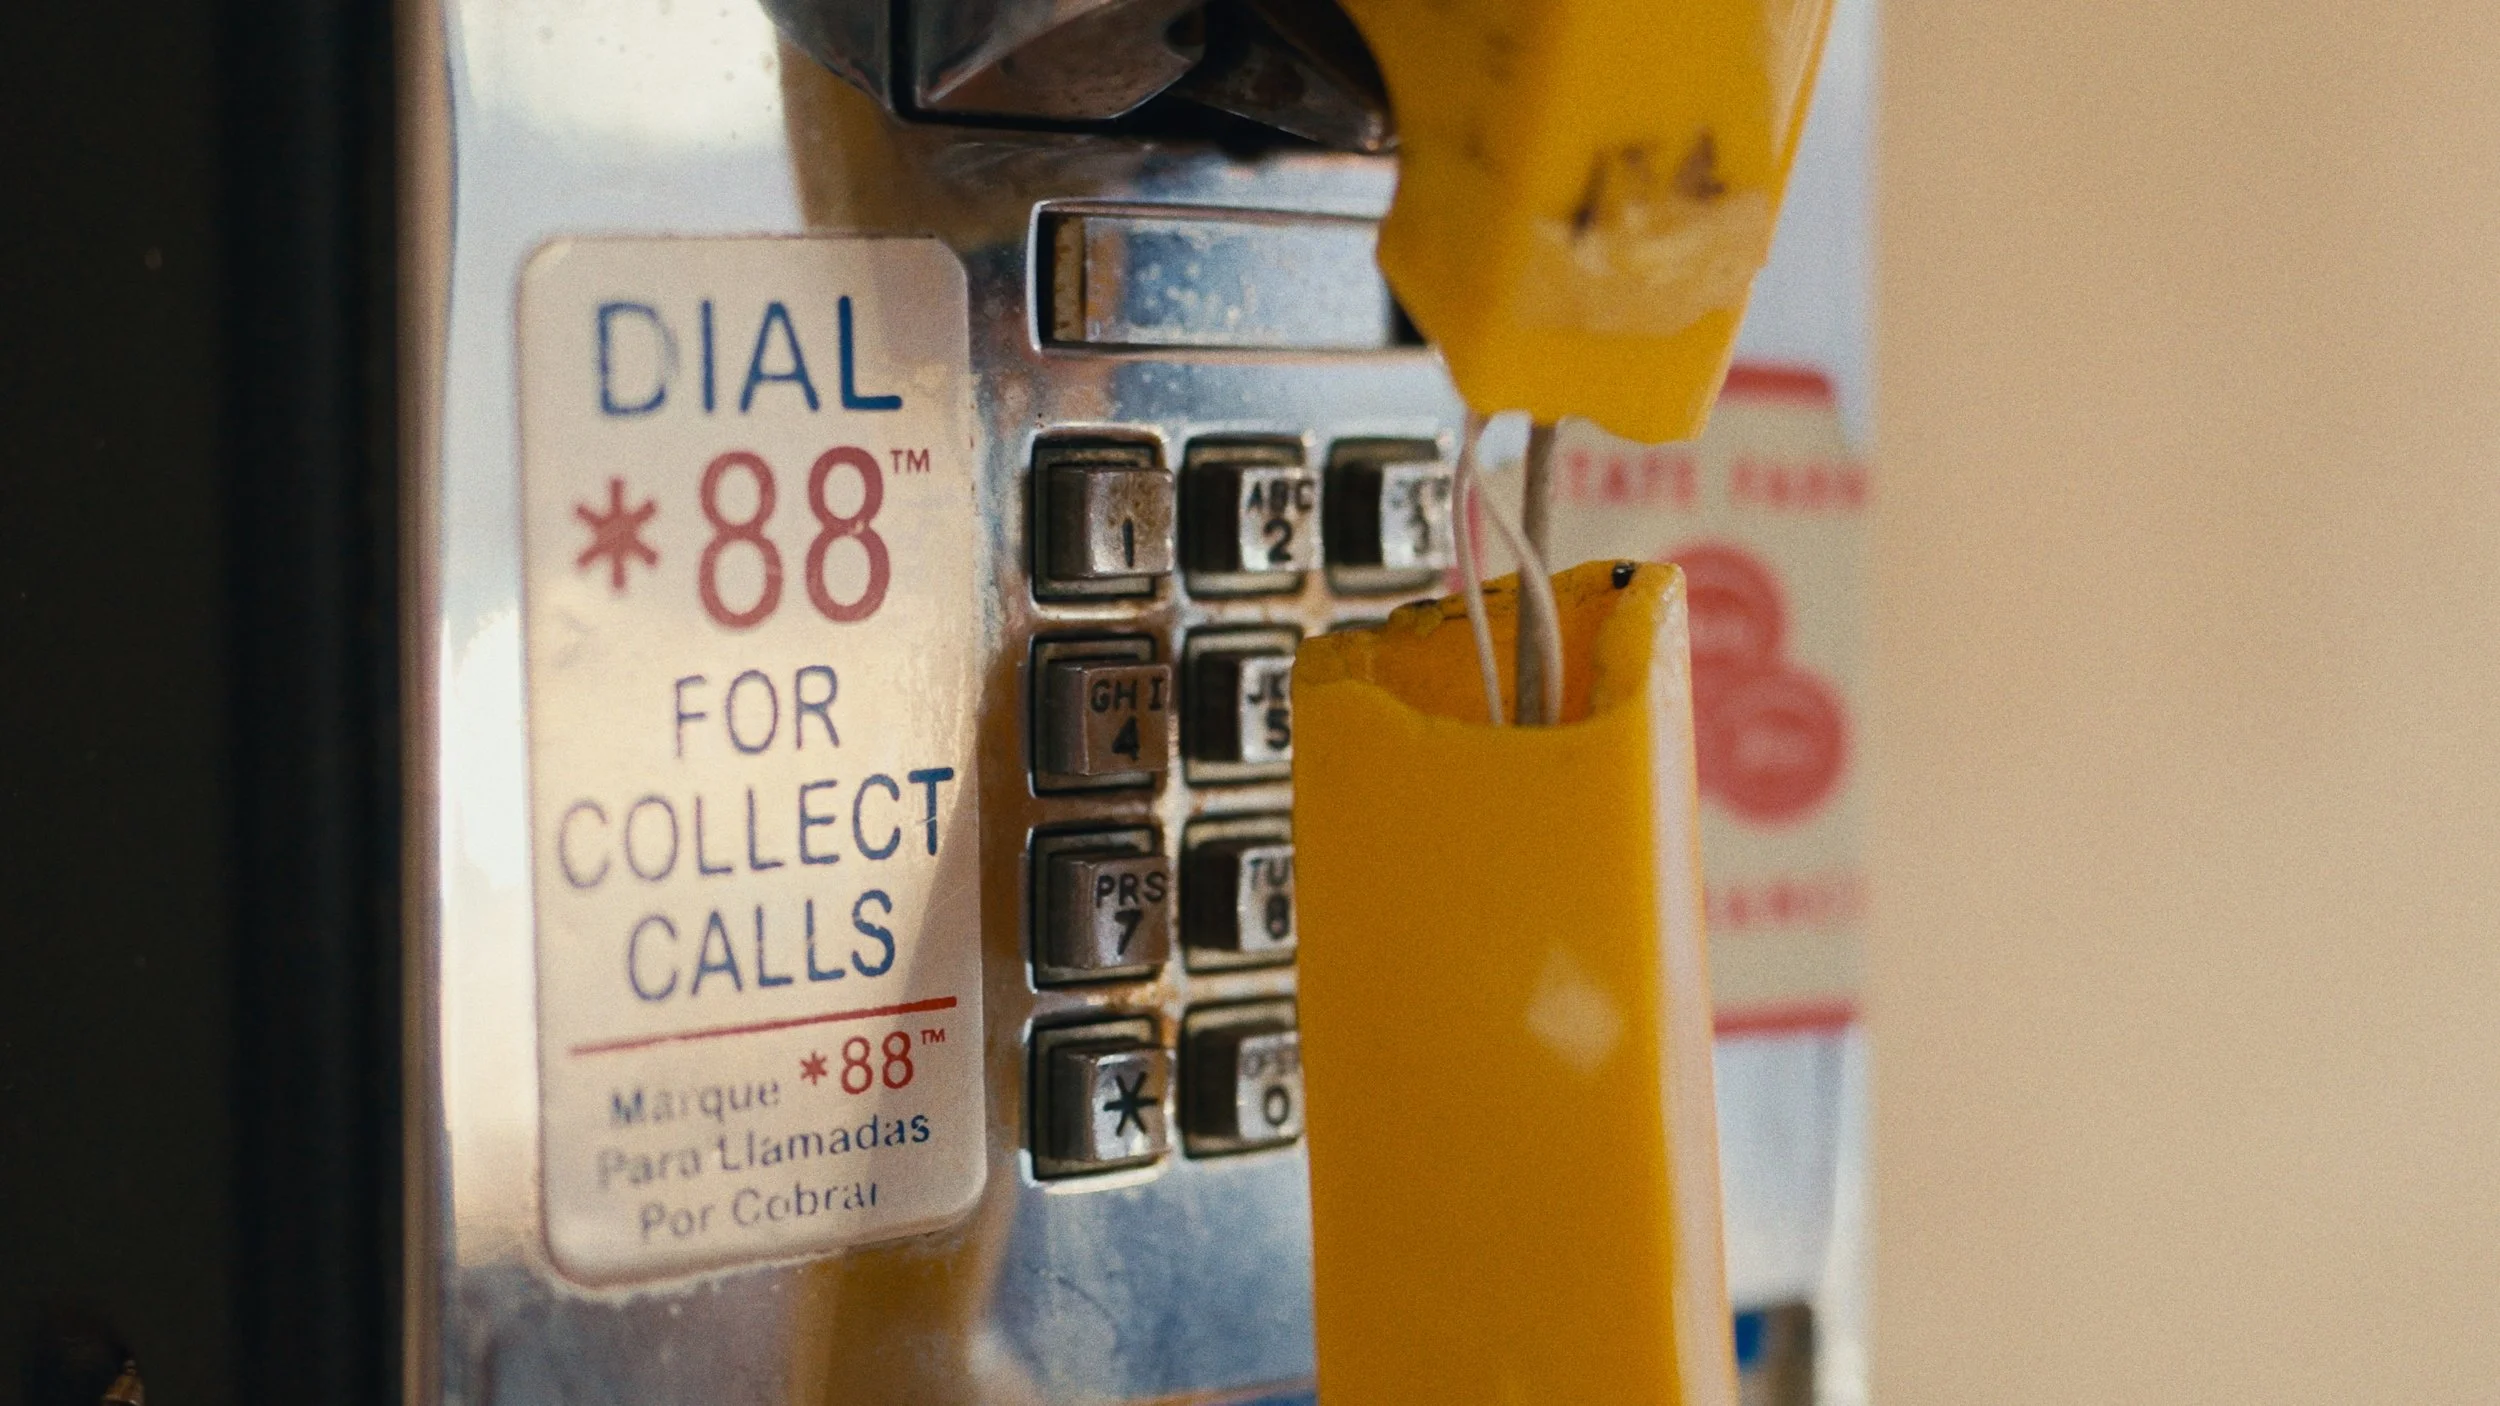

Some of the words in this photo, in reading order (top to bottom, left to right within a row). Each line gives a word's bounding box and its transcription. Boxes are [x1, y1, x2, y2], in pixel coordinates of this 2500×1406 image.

[597, 296, 903, 416] DIAL
[1248, 480, 1315, 514] ABC
[1264, 519, 1292, 563] 2
[1404, 504, 1431, 555] 3
[1091, 679, 1166, 712] GHI
[1248, 671, 1290, 703] JK
[673, 665, 840, 758] FOR
[1266, 709, 1291, 751] 5
[1112, 717, 1140, 761] 4
[558, 766, 955, 889] COLLECT
[1096, 871, 1167, 908] PRS
[1249, 856, 1292, 890] TU
[1114, 909, 1144, 955] 7
[1264, 893, 1291, 940] 8
[627, 889, 897, 1003] CALLS
[1263, 1085, 1290, 1127] 0
[600, 1146, 702, 1187] Para
[717, 1114, 931, 1172] Llamadas
[639, 1204, 715, 1239] Por
